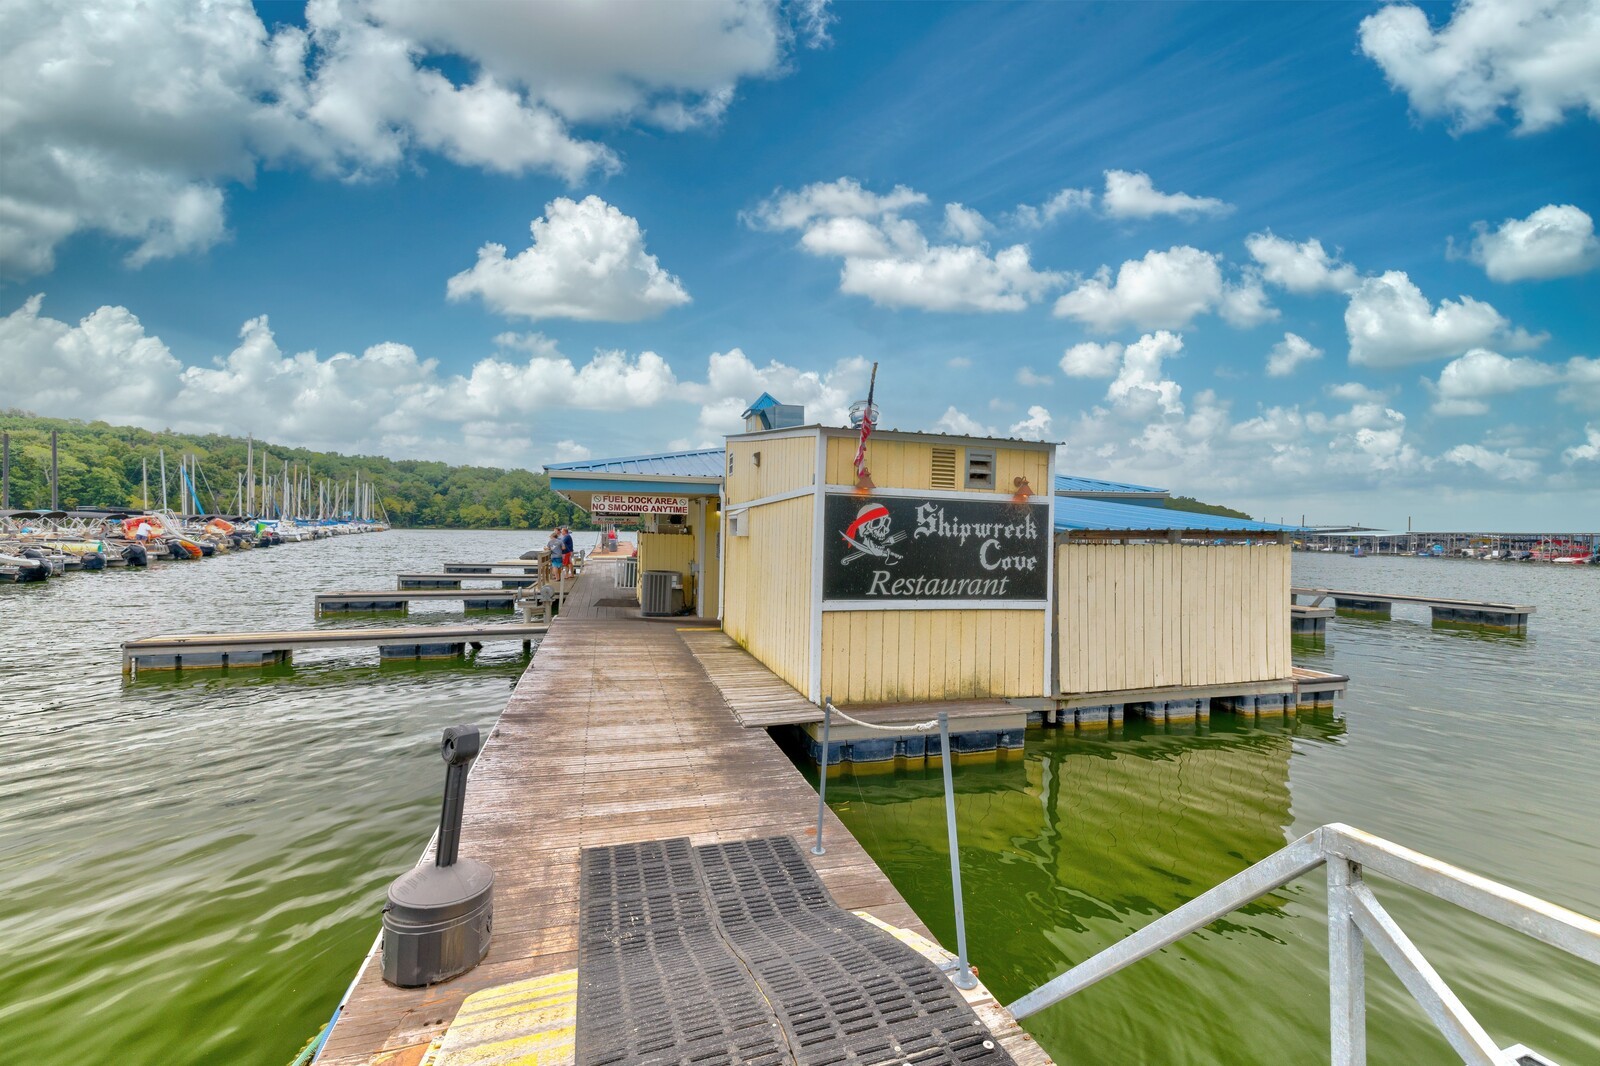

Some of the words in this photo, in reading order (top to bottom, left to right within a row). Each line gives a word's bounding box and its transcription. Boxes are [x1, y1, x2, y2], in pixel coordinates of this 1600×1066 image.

[592, 503, 606, 511] NO
[608, 504, 648, 512] SMOKING
[651, 505, 687, 513] ANYTIME
[628, 496, 653, 504] DOCK
[655, 497, 678, 505] AREA
[913, 502, 1038, 546] Shipwreck
[980, 539, 1038, 571] Cove
[866, 570, 1010, 596] Restaurant
